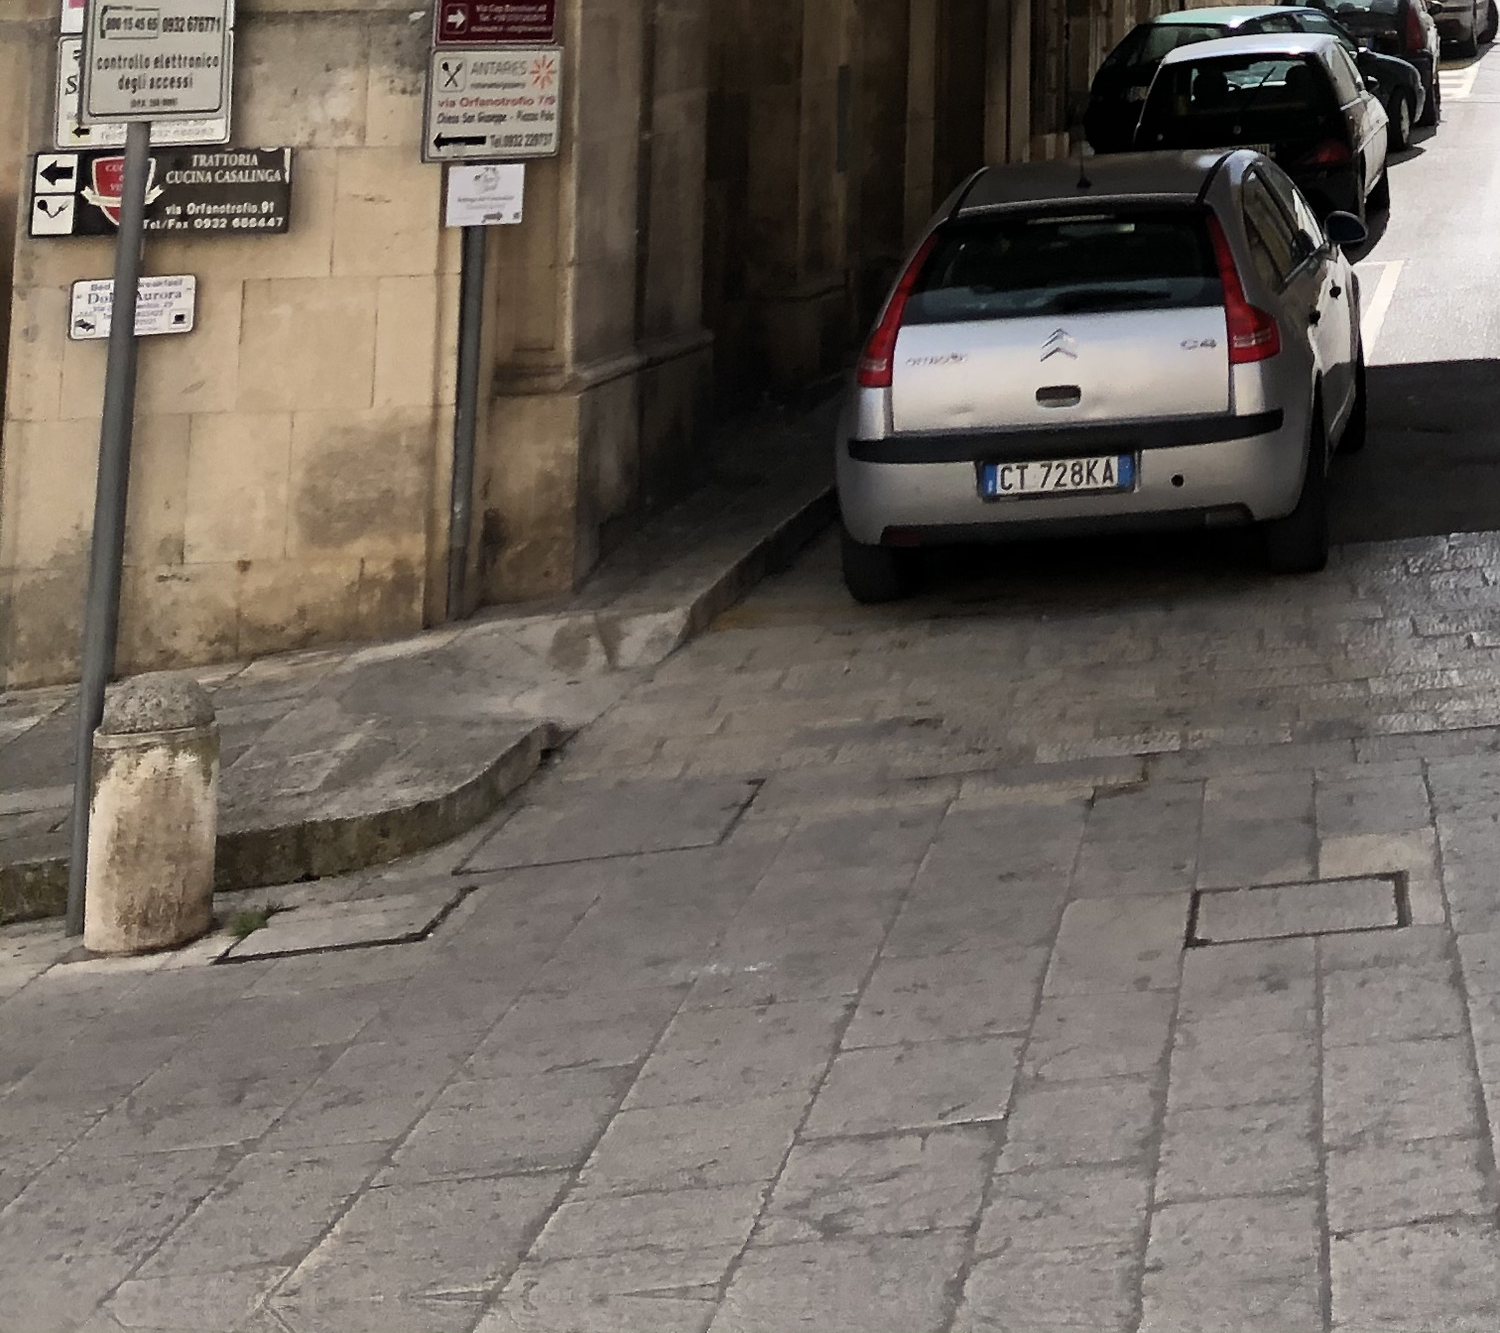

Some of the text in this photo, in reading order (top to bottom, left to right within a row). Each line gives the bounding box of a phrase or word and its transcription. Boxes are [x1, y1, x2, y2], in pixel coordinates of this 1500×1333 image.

[162, 17, 185, 33] 0932
[97, 53, 219, 70] controllo elettronico
[469, 60, 527, 76] ANTARES
[117, 73, 194, 93] degli accessi
[438, 98, 456, 108] via
[459, 96, 534, 108] Orfanotrofio
[192, 153, 259, 167] TRATTORIA
[166, 169, 281, 184] CUCINA CASALINGA
[165, 205, 182, 215] via
[143, 219, 189, 231] Tel/Fax
[193, 218, 228, 229] 0932
[1000, 459, 1115, 491] CT 728KA
